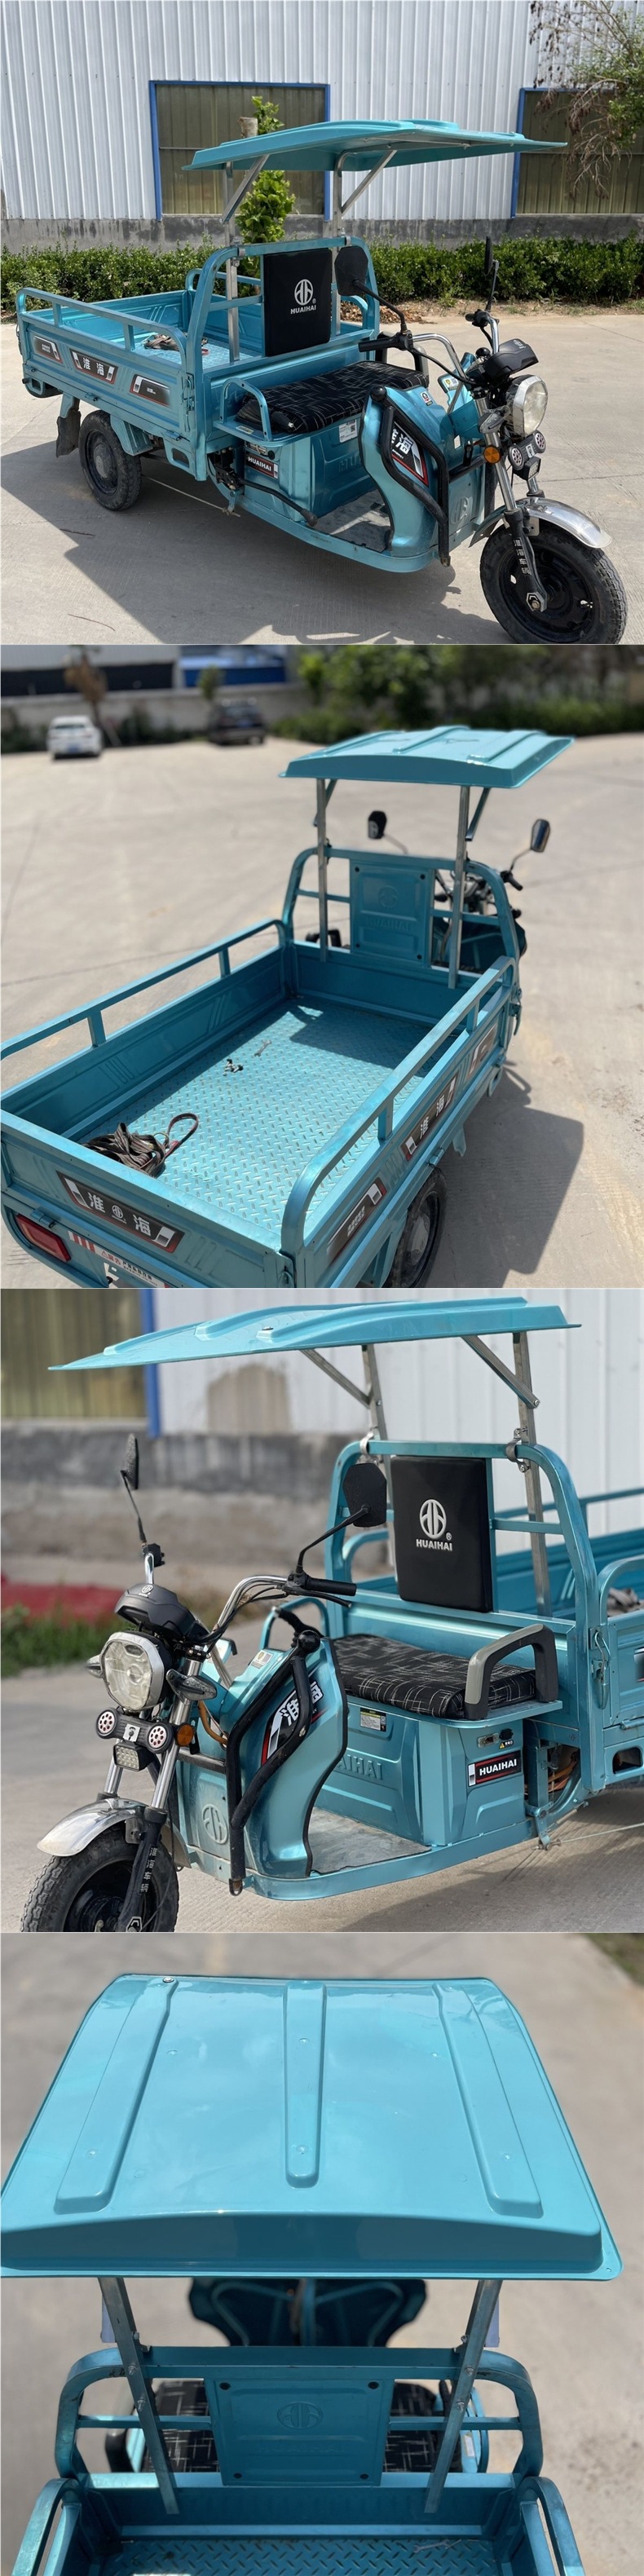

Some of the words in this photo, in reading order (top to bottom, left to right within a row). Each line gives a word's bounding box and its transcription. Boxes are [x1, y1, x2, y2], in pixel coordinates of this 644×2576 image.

[290, 305, 316, 315] HUAIHAI
[248, 457, 271, 471] HUAIHAI
[416, 1538, 453, 1551] HUAIHAI
[479, 1758, 517, 1776] HUAIHAI
